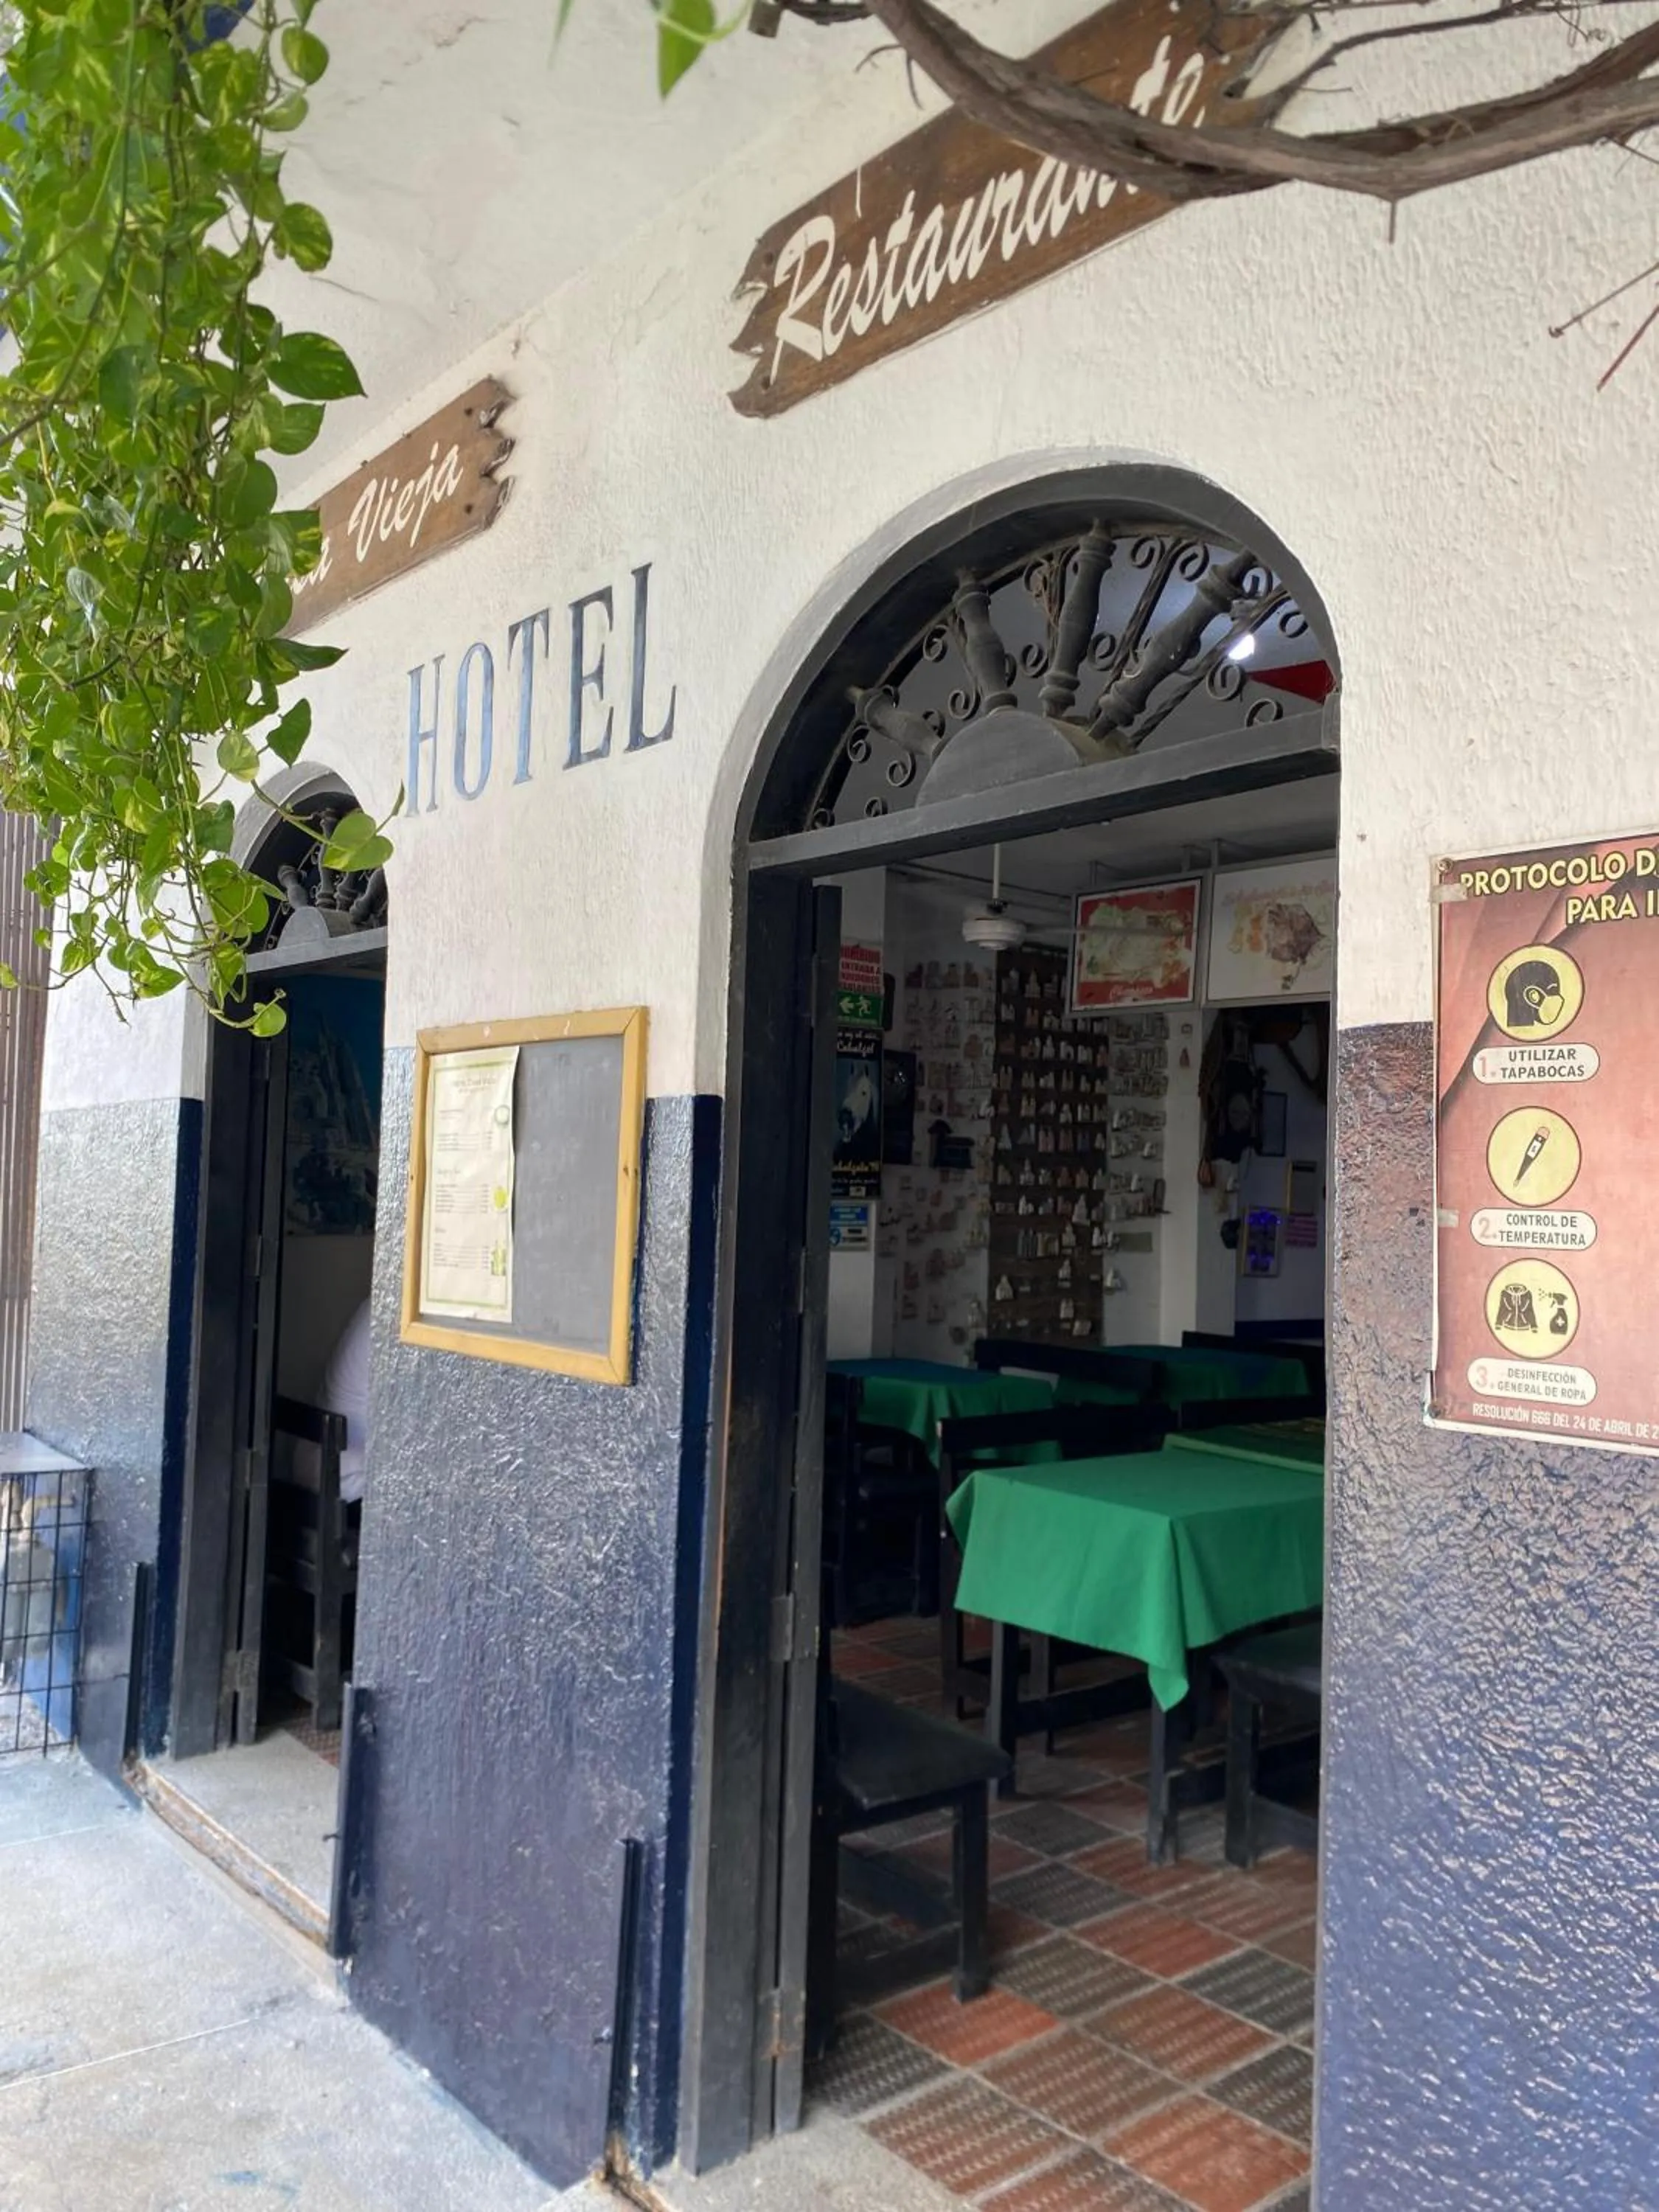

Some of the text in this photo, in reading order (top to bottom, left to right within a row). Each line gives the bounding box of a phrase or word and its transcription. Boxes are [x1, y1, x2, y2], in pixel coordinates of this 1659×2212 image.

[348, 441, 464, 563] Vieja
[406, 563, 677, 818] HOTEL
[1460, 849, 1659, 897] PROTOCOLO D
[1567, 892, 1638, 925] PARA
[1508, 1048, 1576, 1062] UTILIZAR
[1500, 1064, 1585, 1079] TAPABOCAS
[1506, 1213, 1578, 1228] CONTROL DE
[1498, 1230, 1586, 1246] TEMPERATURA
[1507, 1367, 1576, 1384] DESINFECCIÓN
[1498, 1380, 1587, 1400] GENERAL DE ROPA
[1472, 1402, 1530, 1424] RESOLUCIÓN
[1552, 1412, 1571, 1428] DEL
[1572, 1414, 1587, 1430] 24
[1588, 1416, 1602, 1433] DE
[1604, 1419, 1635, 1437] ABRIL
[1635, 1422, 1649, 1439] DE
